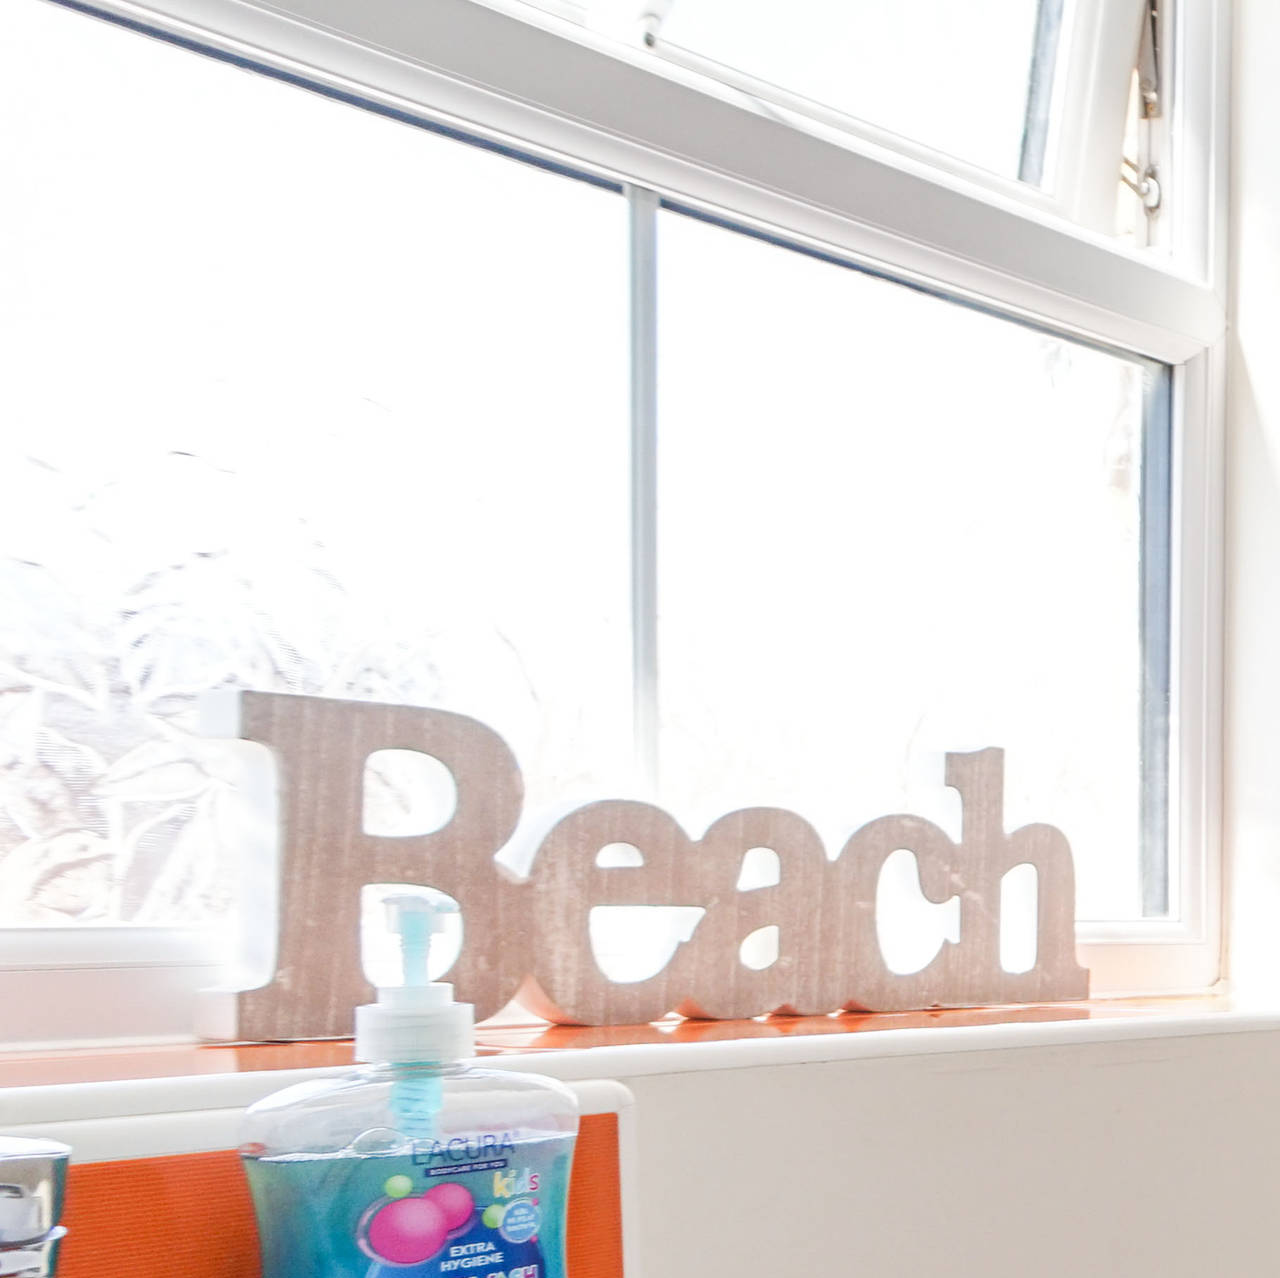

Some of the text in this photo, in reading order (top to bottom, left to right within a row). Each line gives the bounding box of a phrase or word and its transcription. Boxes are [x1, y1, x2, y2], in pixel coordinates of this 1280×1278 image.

[236, 690, 1090, 1041] Beach
[412, 1133, 516, 1165] LACURA
[493, 1168, 539, 1198] kids
[440, 1252, 504, 1272] HYGIENE
[450, 1242, 496, 1257] EXTRA
